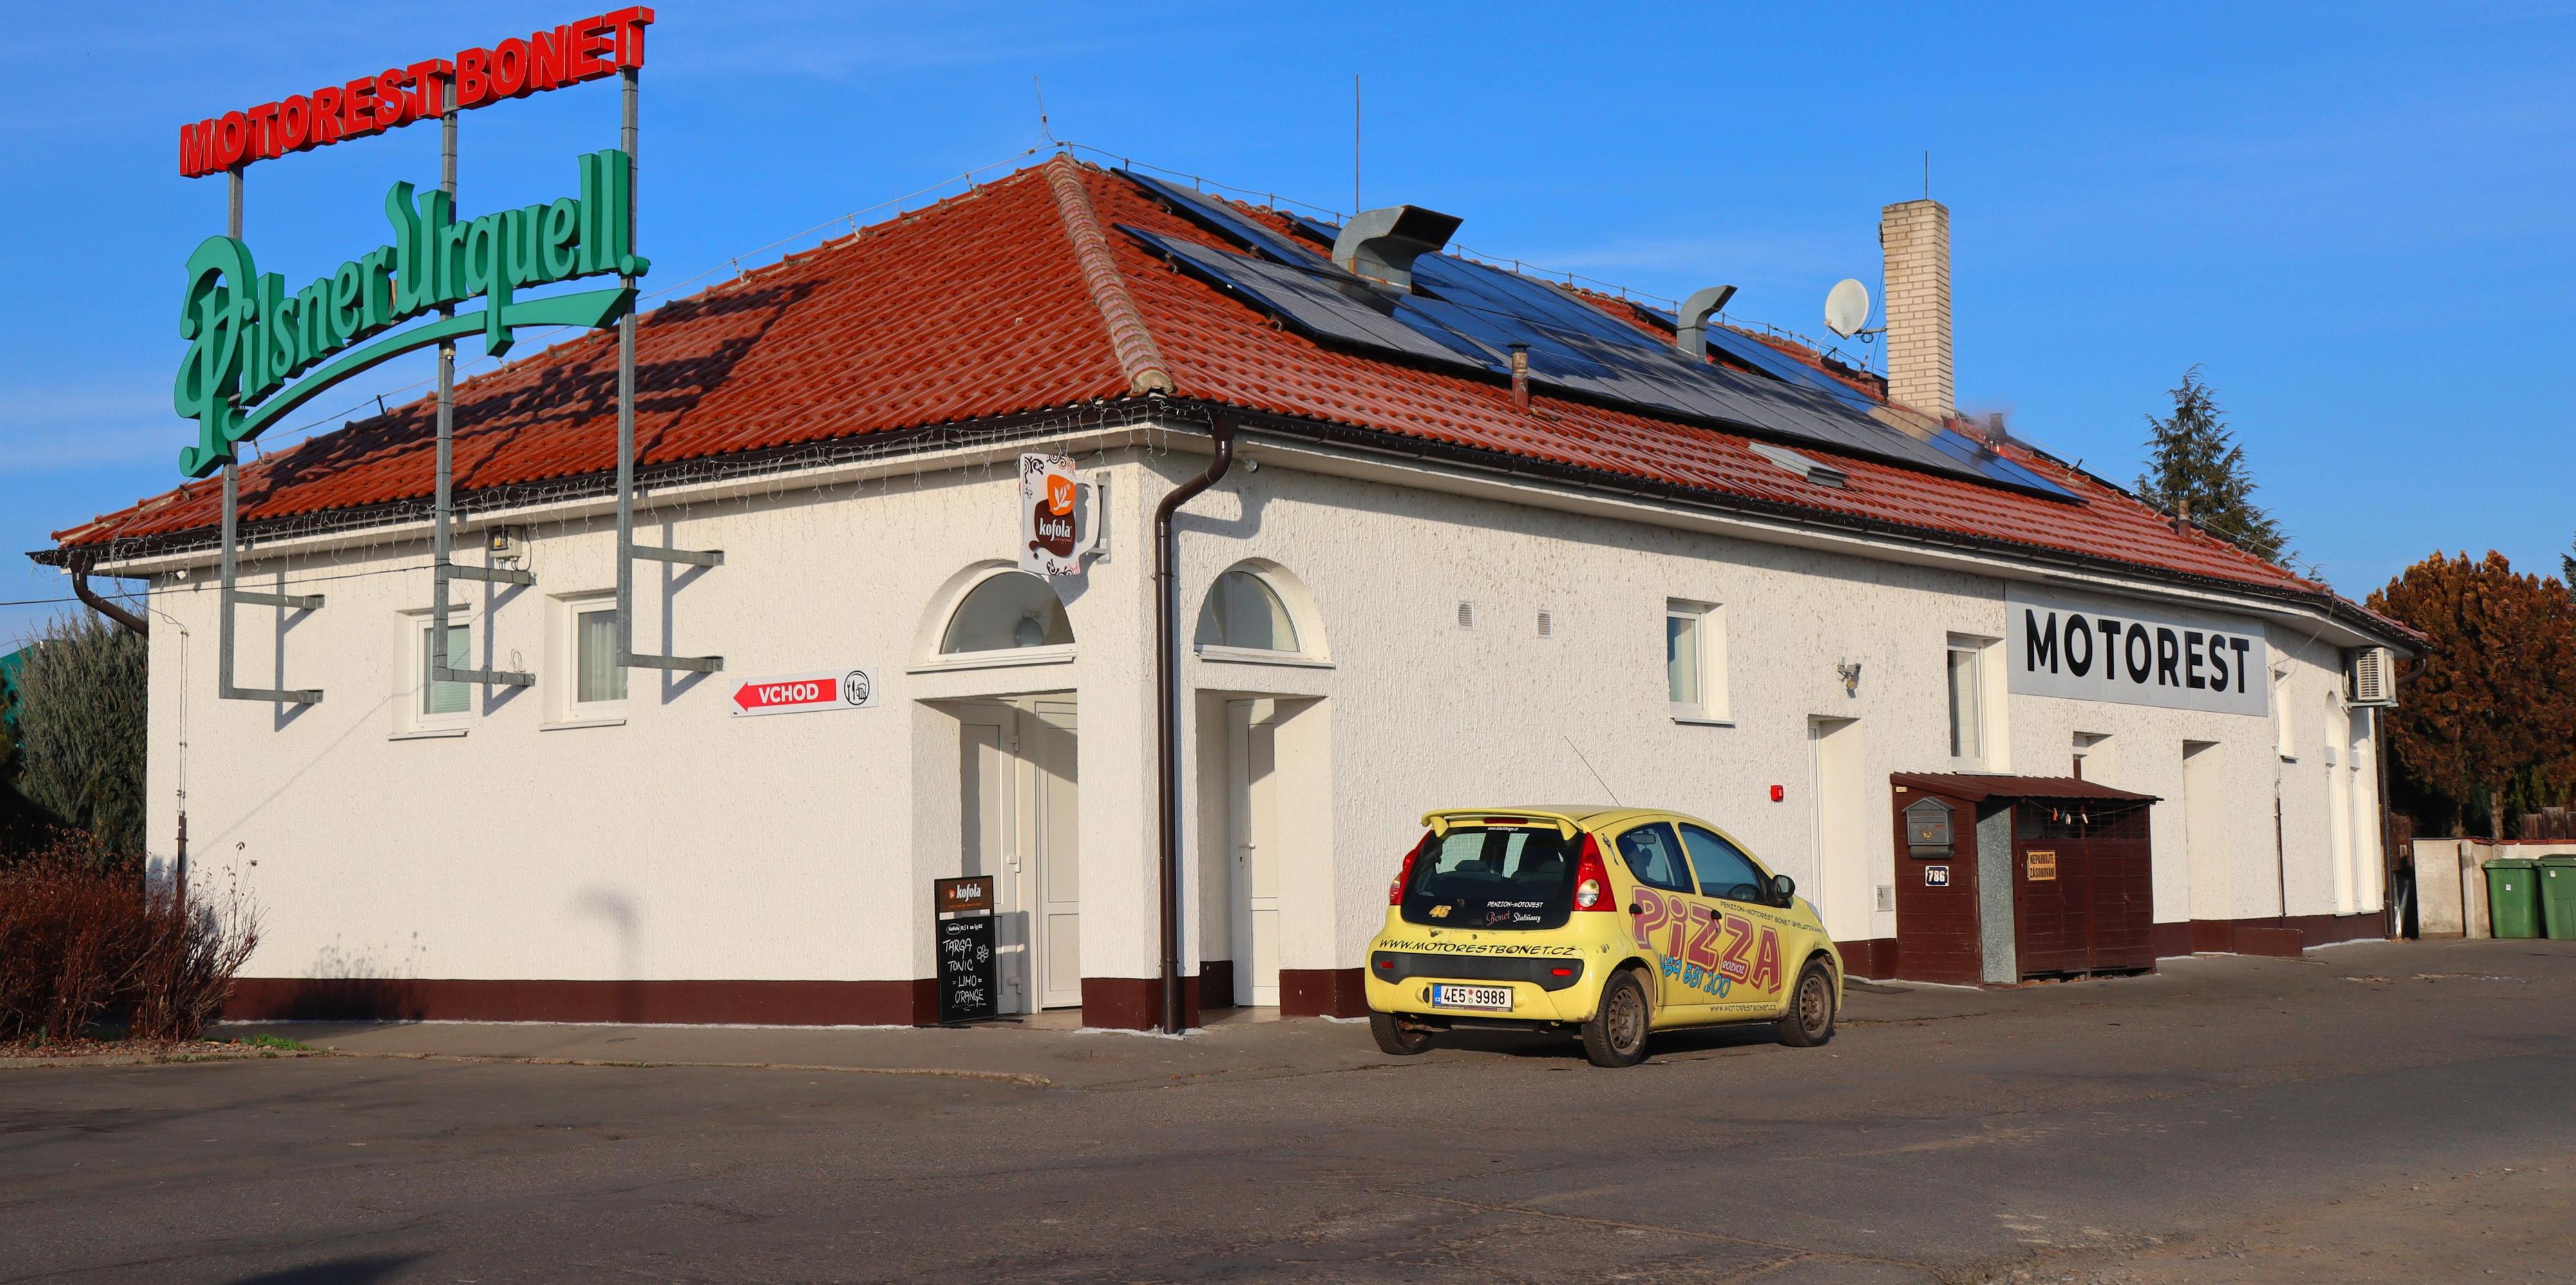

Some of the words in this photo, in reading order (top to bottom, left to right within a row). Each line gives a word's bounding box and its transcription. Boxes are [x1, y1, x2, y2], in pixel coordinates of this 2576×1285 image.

[180, 59, 453, 178] MOTOREST
[456, 5, 654, 109] BONET
[175, 235, 397, 478] Pilsner
[1039, 518, 1072, 542] kofola
[2025, 609, 2249, 694] MOTOREST
[758, 683, 819, 703] VCHOD
[1927, 870, 1946, 882] 786
[956, 883, 981, 902] kofola
[1428, 904, 1452, 919] 46
[1486, 910, 1510, 926] Bonet
[1774, 917, 1791, 926] BONET
[943, 938, 972, 959] TARGA
[947, 958, 974, 973] TONIC
[1722, 960, 1745, 975] ROZVOZ
[1659, 953, 1683, 982] 469
[1683, 964, 1705, 989] 681
[1703, 970, 1732, 999] 200
[955, 989, 984, 1007] ORANGE
[1444, 987, 1466, 1003] 4E5
[1475, 990, 1506, 1005] 9988
